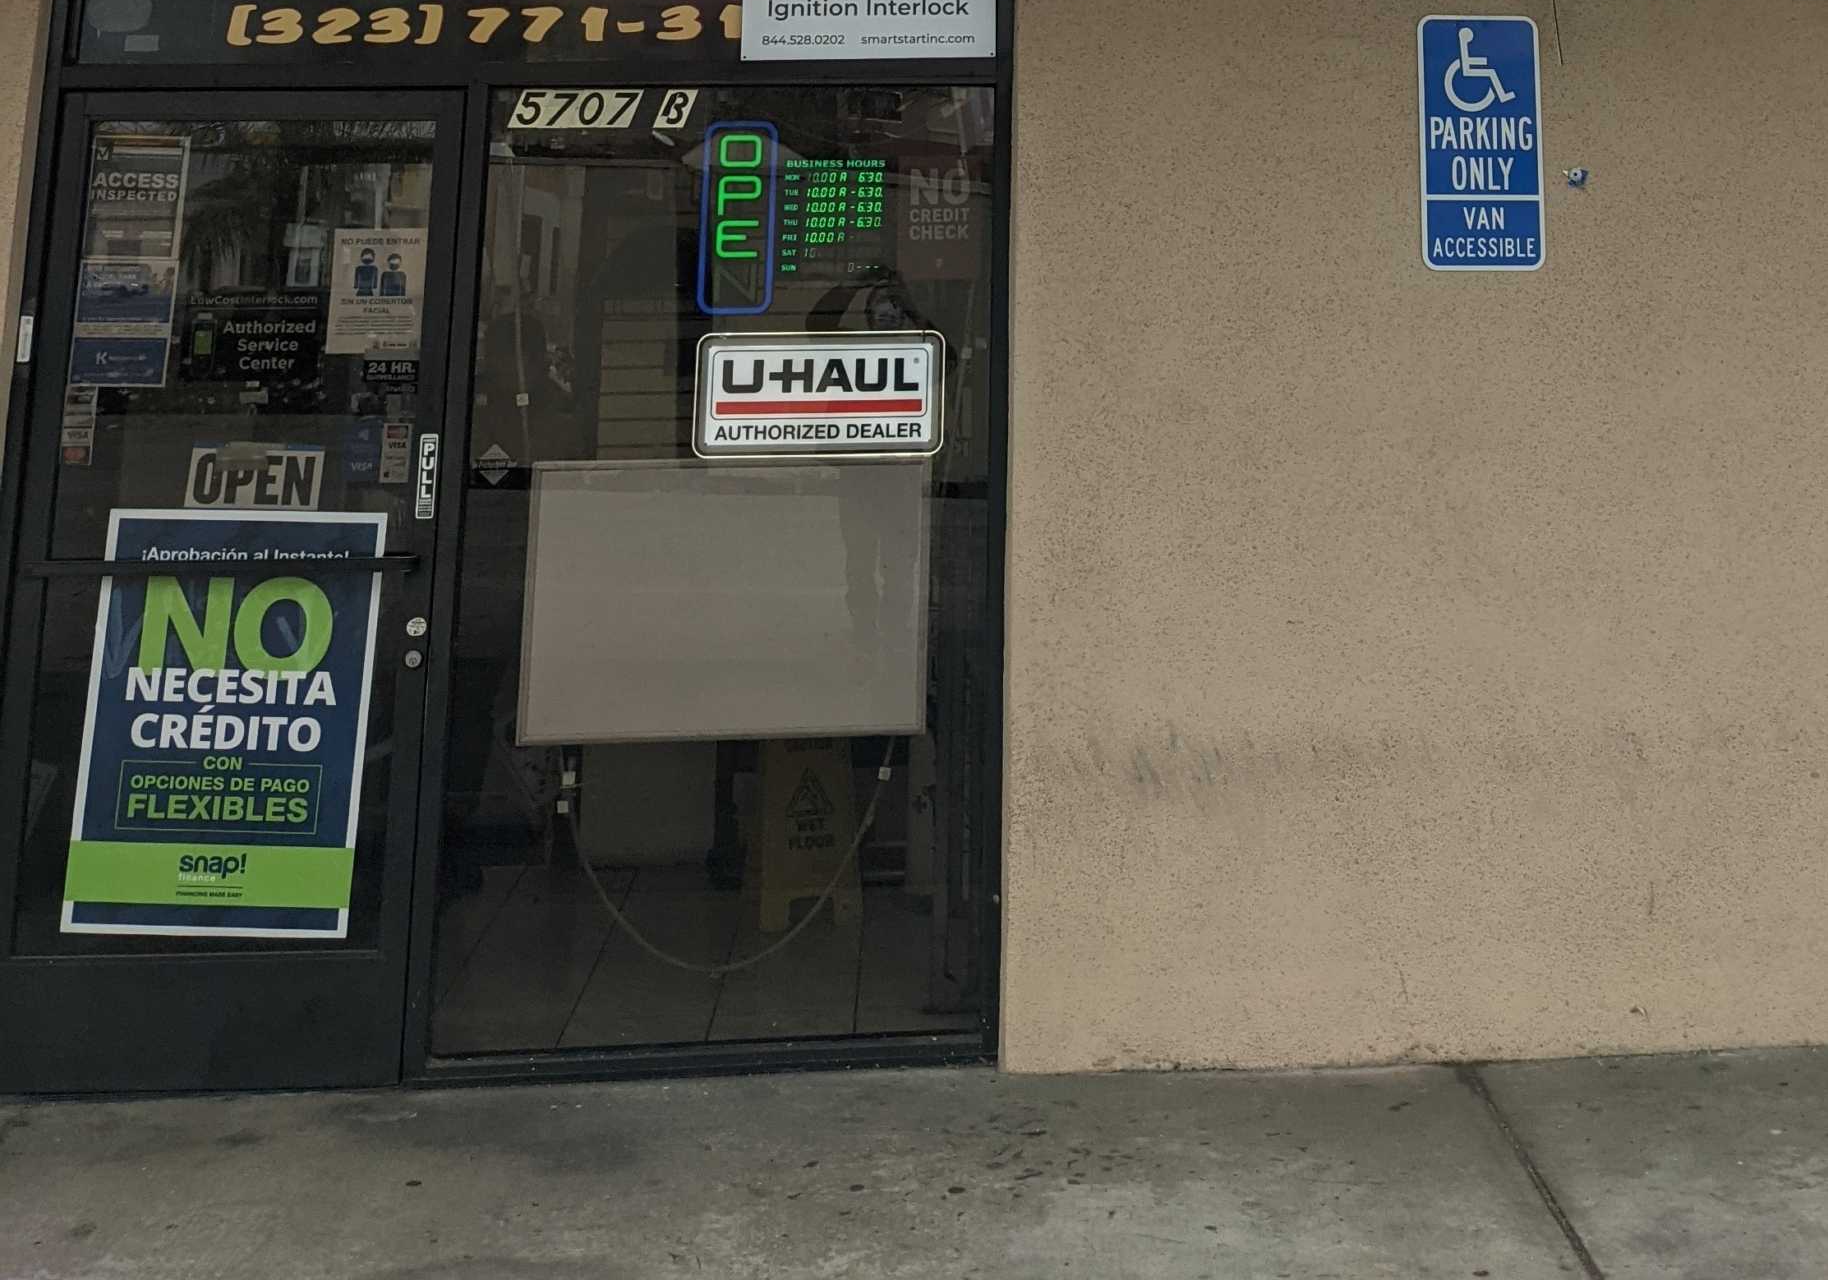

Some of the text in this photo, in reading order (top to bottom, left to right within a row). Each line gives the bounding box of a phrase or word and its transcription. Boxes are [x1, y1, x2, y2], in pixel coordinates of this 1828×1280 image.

[762, 33, 976, 47] 844.528.0202 smartstartinc.com
[516, 91, 689, 126] 5707 B
[1430, 116, 1533, 151] PARKING
[786, 160, 886, 168] BUSINESS HOURS
[1451, 155, 1514, 191] ONLY
[93, 171, 179, 189] ACCESS
[910, 167, 971, 206] NO
[91, 189, 178, 202] INSPECTED
[716, 134, 763, 303] OPEN
[909, 207, 971, 223] CREDIT
[1463, 207, 1504, 230] VAN
[909, 224, 969, 241] CHECK
[1433, 237, 1537, 258] ACCESSIBLE
[223, 319, 317, 334] Authorized
[236, 337, 299, 352] Service
[239, 356, 296, 370] Center
[367, 361, 416, 374] 24 HR.
[722, 358, 919, 394] U-HAUL
[67, 431, 89, 440] VISA
[714, 423, 922, 441] AUTHORIZED DEALER
[388, 441, 407, 449] VISA
[193, 453, 316, 506] OPEN
[421, 443, 435, 498] PULL
[138, 576, 333, 677] NO
[125, 667, 337, 706] NECESITA
[130, 705, 322, 752] CRÉDITO
[203, 755, 243, 771] CON
[130, 775, 310, 793] OPCIONES DE PAGO
[127, 793, 308, 824] FLEXIBLES
[179, 853, 247, 879] snap!
